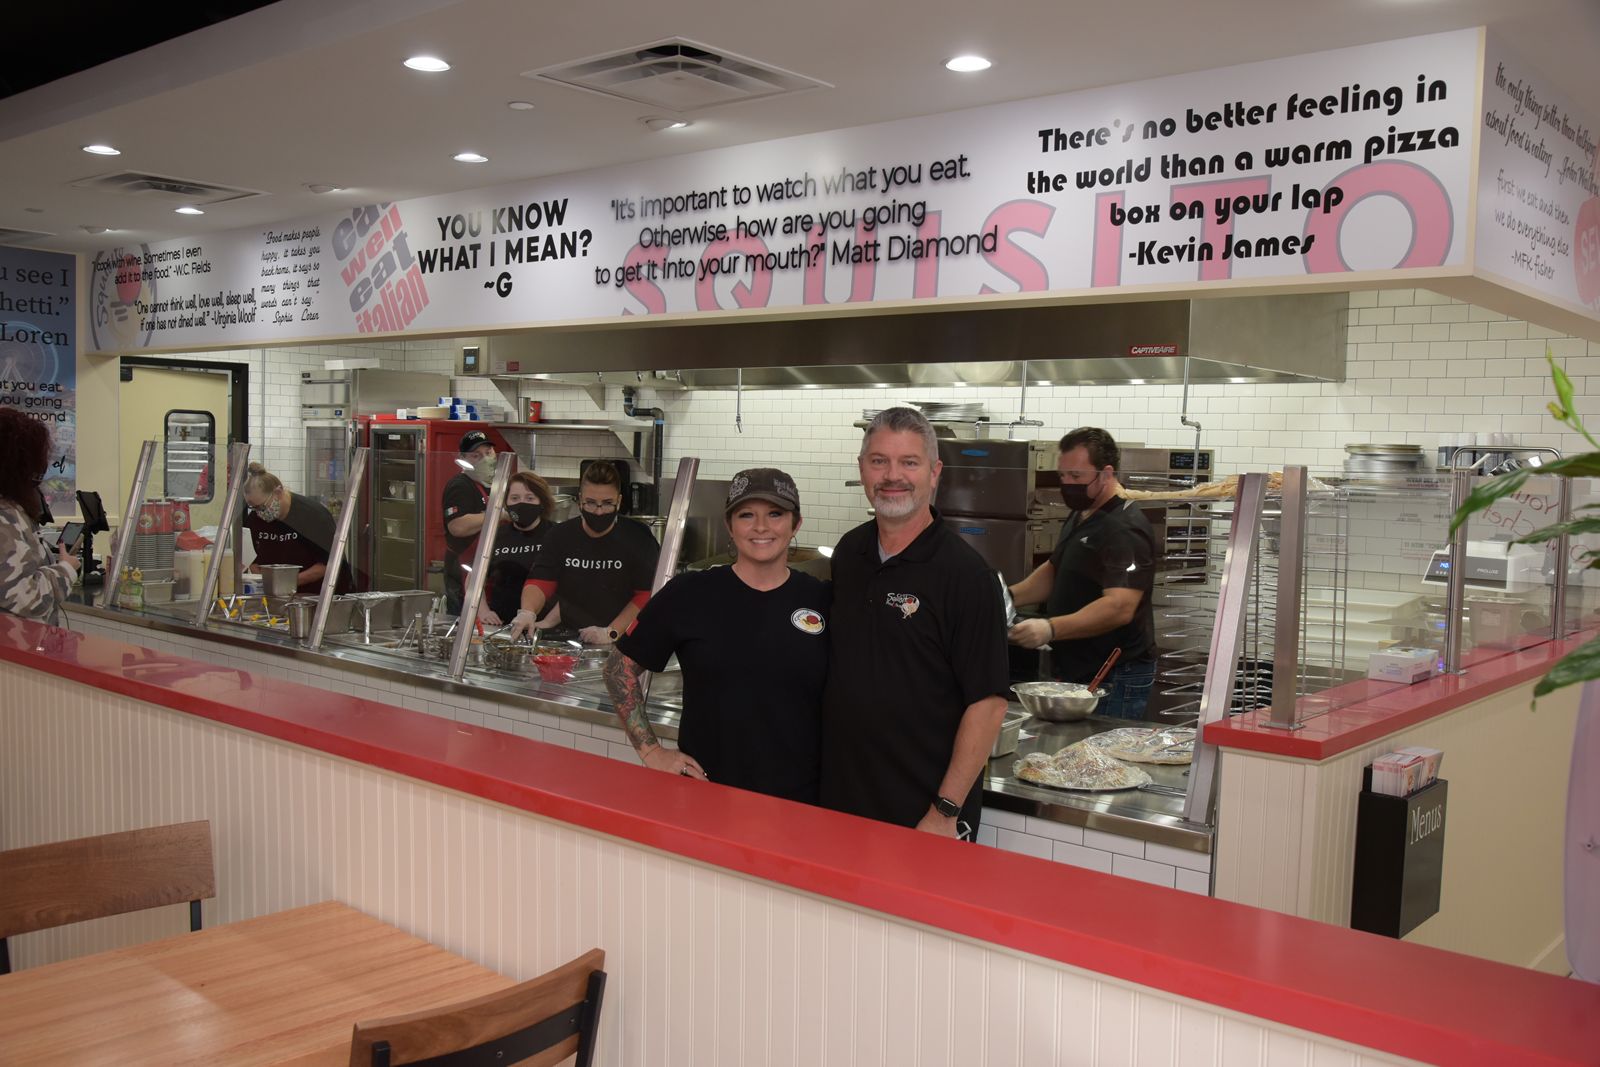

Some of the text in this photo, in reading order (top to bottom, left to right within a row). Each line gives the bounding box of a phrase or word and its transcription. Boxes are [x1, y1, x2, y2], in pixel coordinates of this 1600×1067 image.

[1038, 74, 1448, 153] There's no better feeling in
[1027, 125, 1460, 195] the world than a warm pizza
[640, 186, 727, 220] important
[733, 184, 751, 205] to
[756, 172, 817, 203] watch
[822, 166, 877, 196] what
[881, 163, 922, 194] you
[929, 154, 971, 181] eat.
[1109, 183, 1344, 227] box on your lap
[437, 198, 570, 242] YOU KNOW
[639, 199, 926, 249] Otherwise, how are you going
[144, 249, 180, 265] Sometimes
[186, 246, 202, 257] even
[418, 229, 593, 275] WHAT I MEAN?
[595, 264, 611, 285] to
[615, 262, 643, 288] get
[647, 259, 658, 280] it
[662, 257, 696, 280] into
[698, 255, 740, 281] your
[831, 239, 881, 266] Matt
[887, 225, 998, 262] Diamond
[1128, 232, 1315, 266] -Kevin James
[15, 269, 54, 285] see
[60, 269, 69, 287] I
[115, 273, 127, 284] add
[128, 272, 133, 282] it
[133, 272, 141, 281] to
[142, 269, 153, 280] the
[191, 260, 211, 274] Fields
[0, 322, 69, 346] Loren
[11, 381, 35, 393] you
[25, 395, 62, 409] going
[495, 544, 542, 556] SQUISIT
[565, 558, 622, 569] SQUISITO
[1410, 804, 1443, 845] Menus
